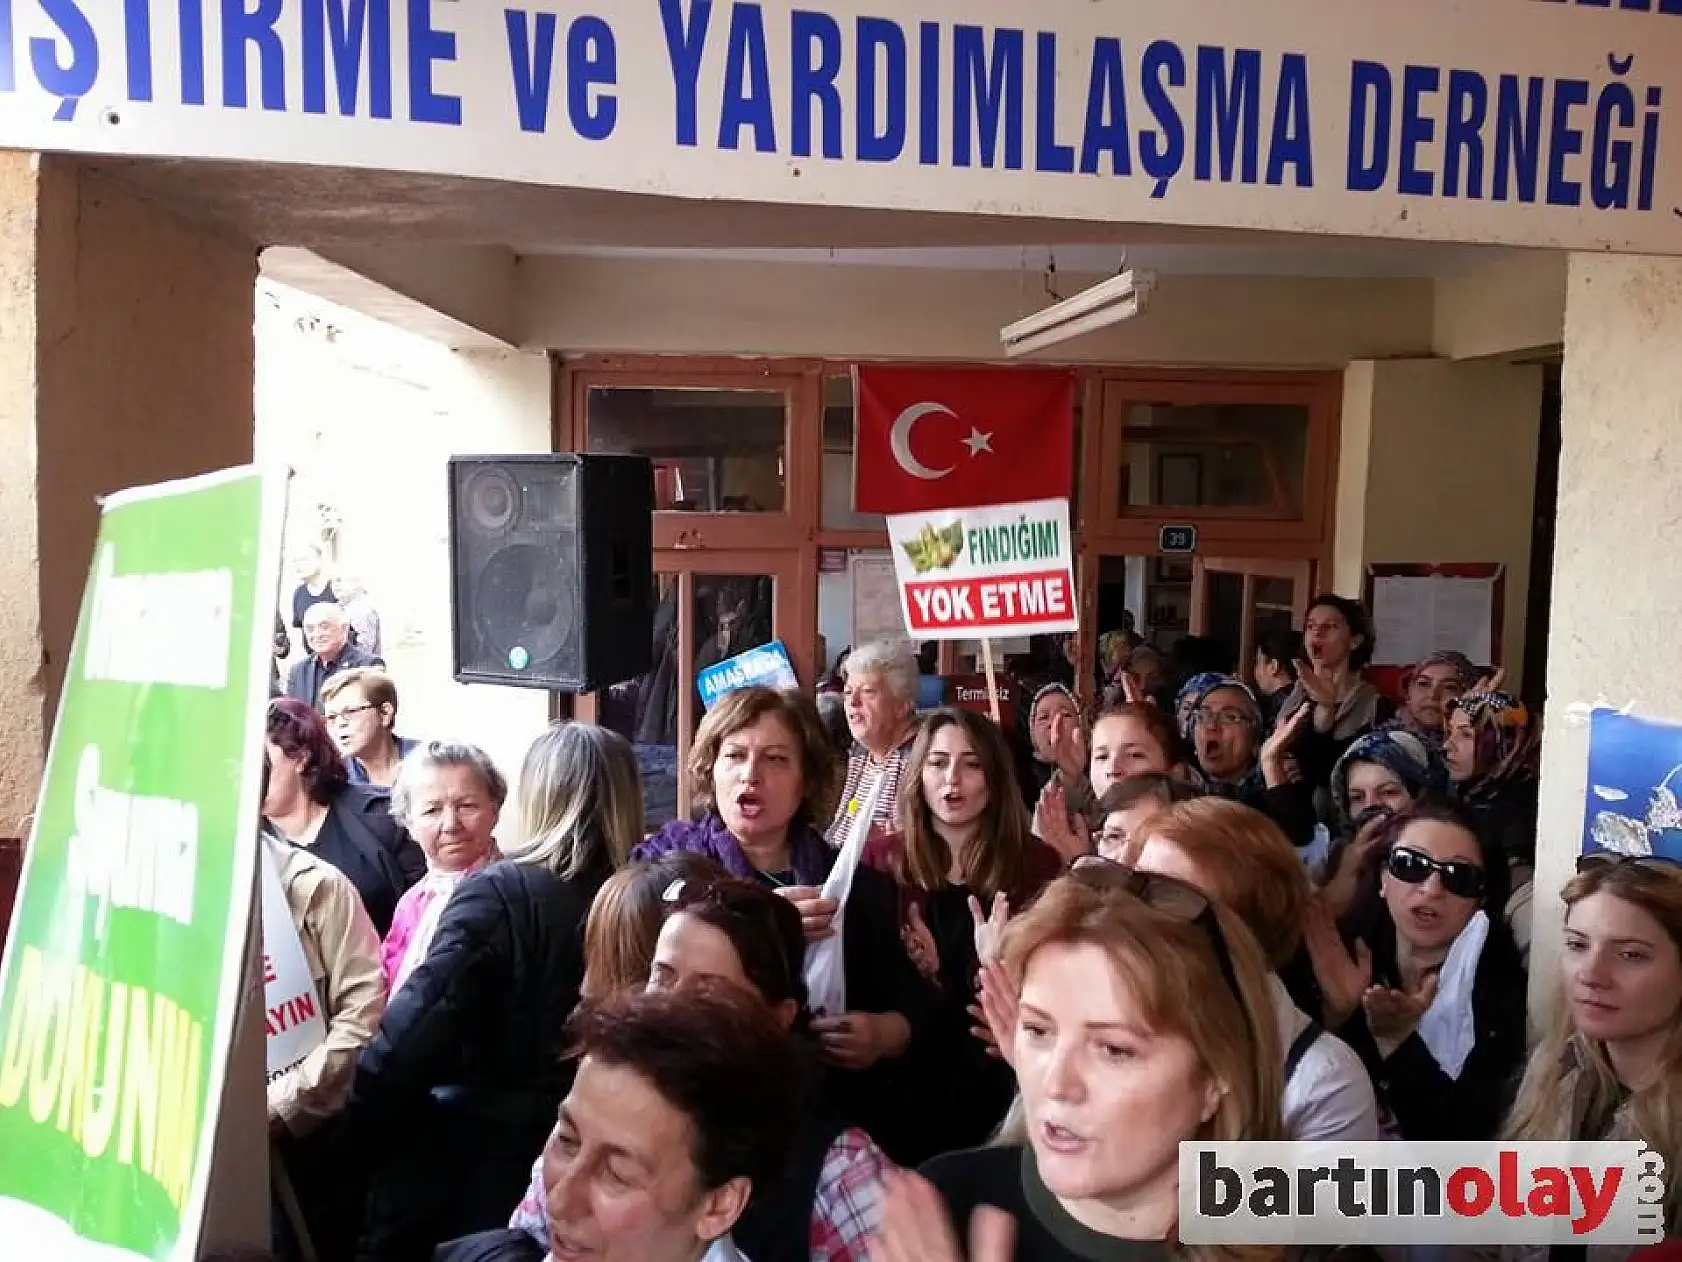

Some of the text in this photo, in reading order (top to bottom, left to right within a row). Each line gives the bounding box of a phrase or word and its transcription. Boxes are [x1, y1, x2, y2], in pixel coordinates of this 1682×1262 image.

[506, 10, 617, 141] ve
[658, 0, 1313, 198] YARDIMLAŞMA
[1346, 52, 1661, 211] DERNEĞİ
[913, 577, 1066, 624] YOK ETME
